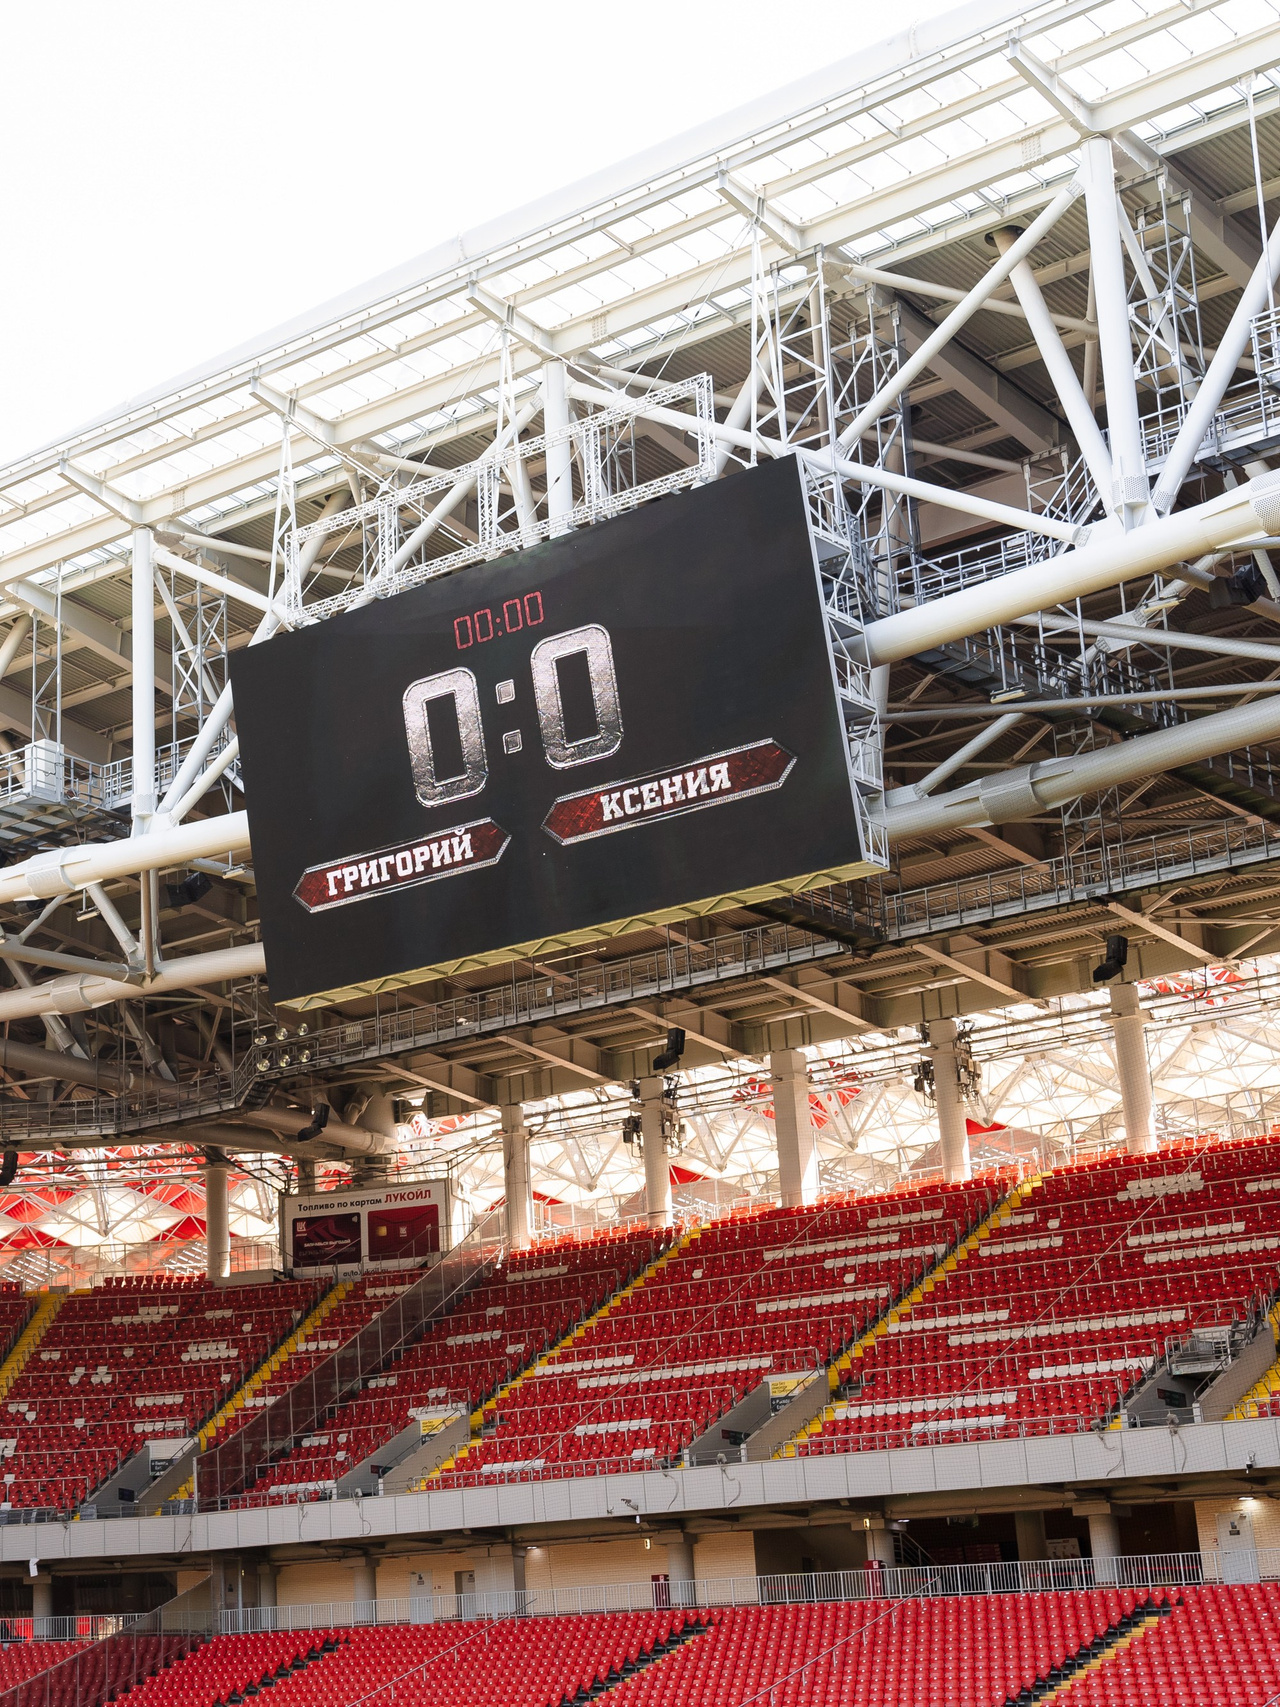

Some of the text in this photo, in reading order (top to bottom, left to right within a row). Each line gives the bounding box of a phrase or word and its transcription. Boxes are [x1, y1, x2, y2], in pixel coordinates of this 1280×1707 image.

[453, 592, 545, 650] 00:00
[402, 622, 625, 809] 0:0
[599, 761, 733, 823] КСЕНИЯ
[325, 828, 475, 898] ГРИГОРИЙ
[298, 1203, 335, 1212] Топливо
[350, 1199, 382, 1207] картам
[384, 1188, 431, 1203] ЛУКОЙЛ
